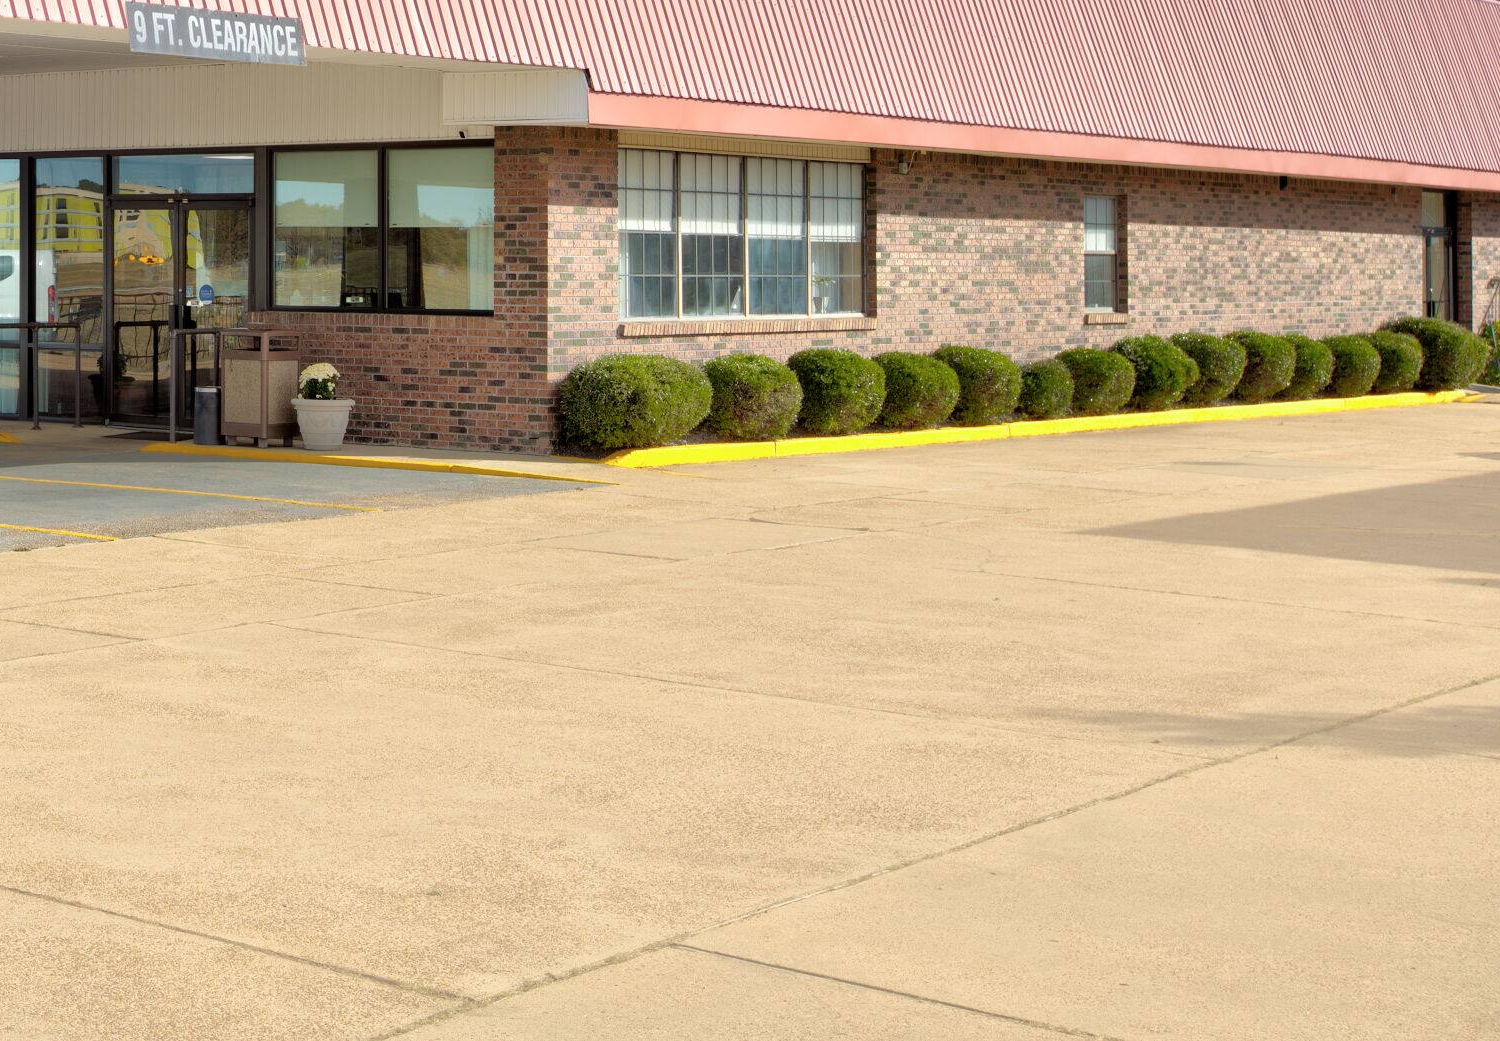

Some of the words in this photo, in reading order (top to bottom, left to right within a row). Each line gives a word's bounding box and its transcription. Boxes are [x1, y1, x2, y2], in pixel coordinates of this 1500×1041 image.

[133, 10, 147, 43] 9
[152, 12, 183, 46] FT.
[188, 15, 298, 57] CLEARANCE
